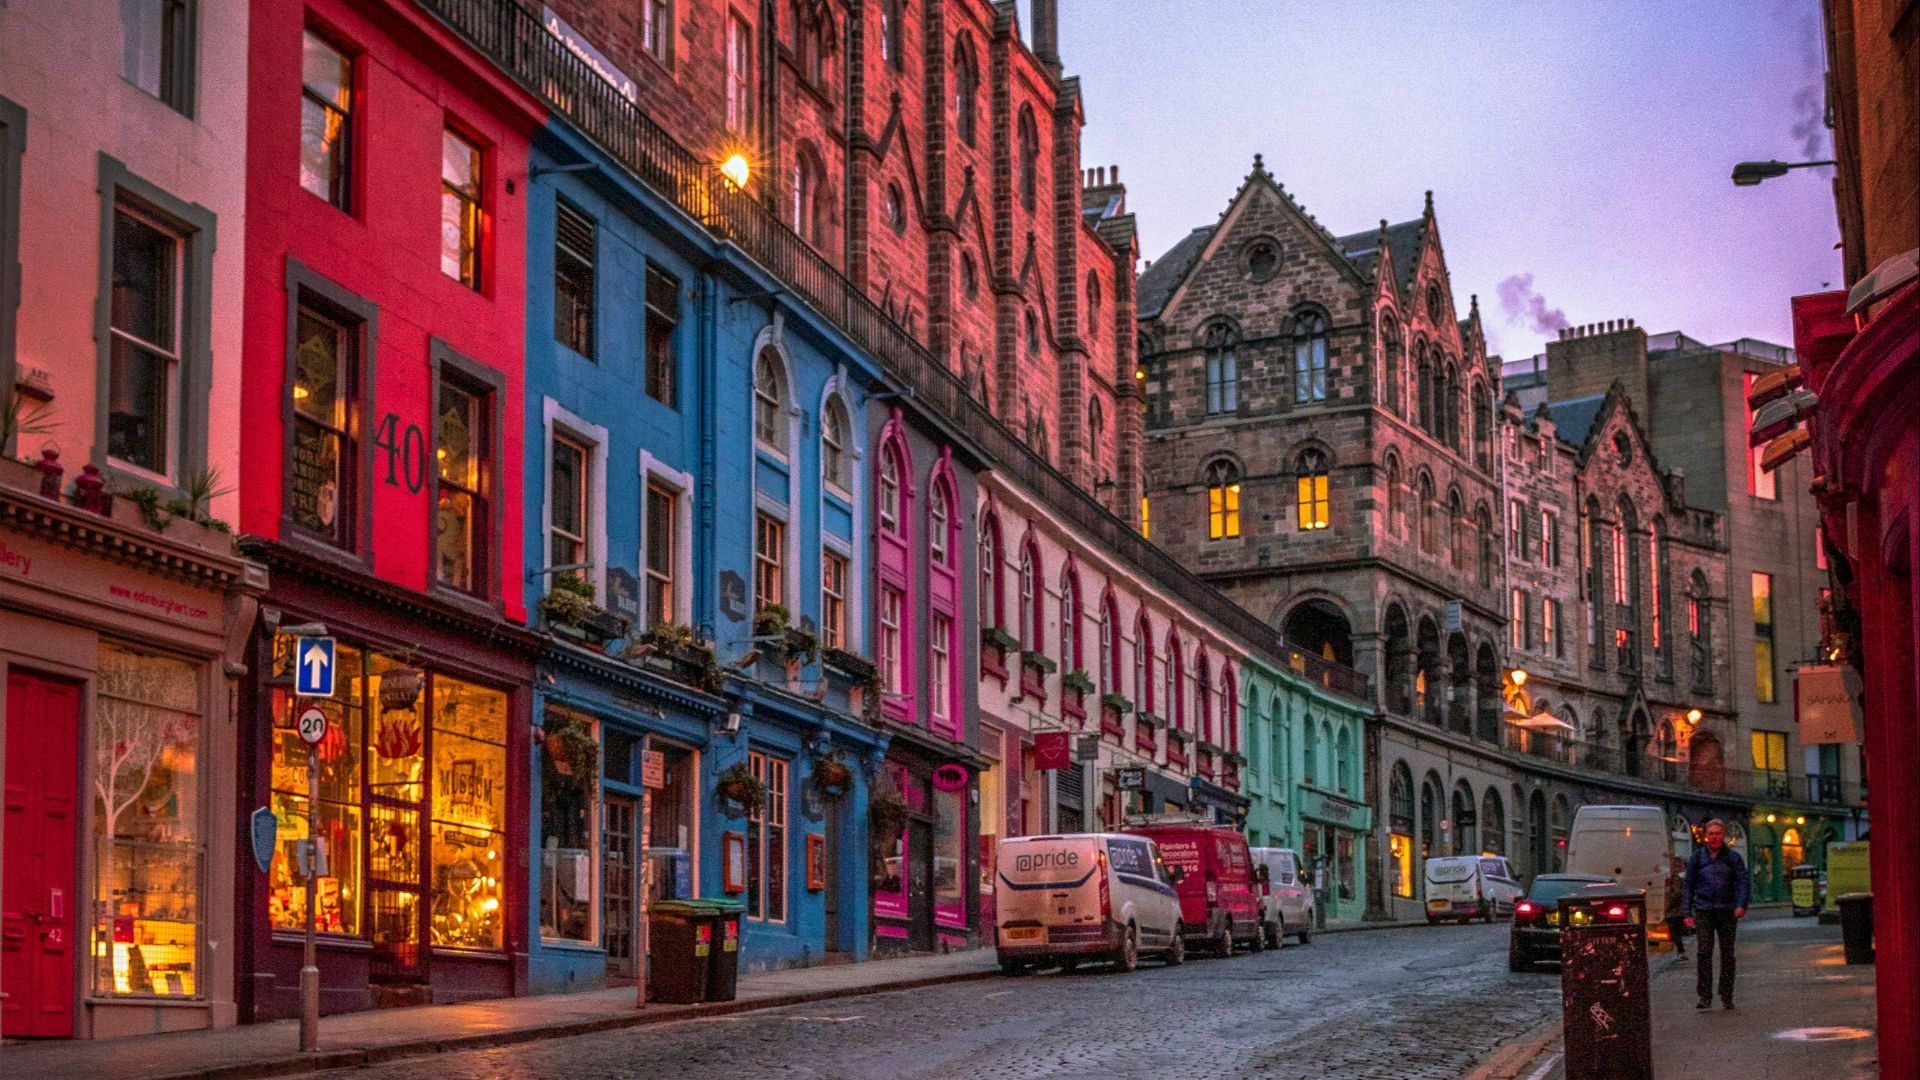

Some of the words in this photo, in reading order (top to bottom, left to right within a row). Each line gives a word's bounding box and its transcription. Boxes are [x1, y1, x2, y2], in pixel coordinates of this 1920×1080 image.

[375, 412, 425, 496] 40
[302, 717, 324, 734] 20
[440, 769, 493, 806] MUSEUM
[1159, 842, 1190, 850] Painters
[1033, 848, 1079, 871] pride
[49, 928, 62, 943] 42
